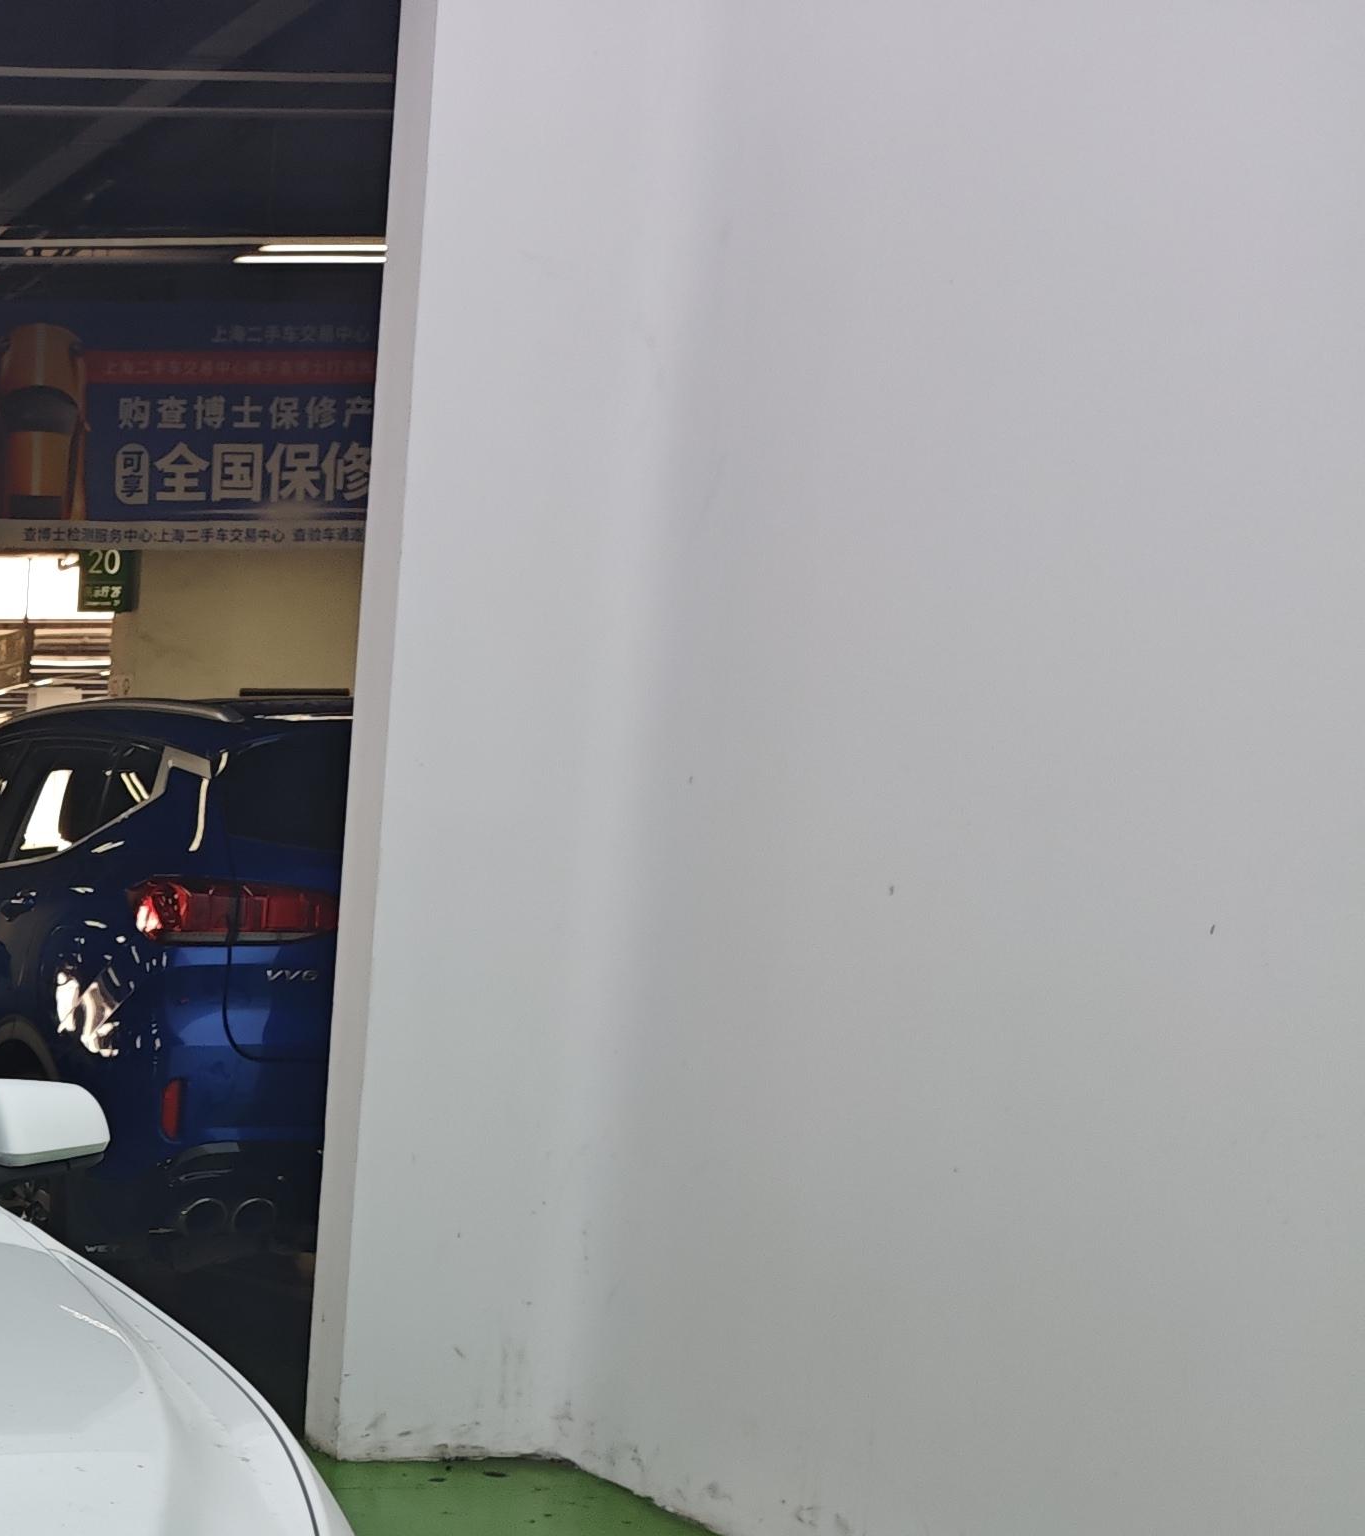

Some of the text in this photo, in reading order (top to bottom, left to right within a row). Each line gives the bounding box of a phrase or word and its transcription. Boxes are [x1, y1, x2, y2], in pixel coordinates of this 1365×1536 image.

[118, 396, 373, 430] 购查博士保修产
[120, 450, 144, 497] 可享
[154, 442, 370, 502] 全国保修
[88, 549, 121, 574] 20
